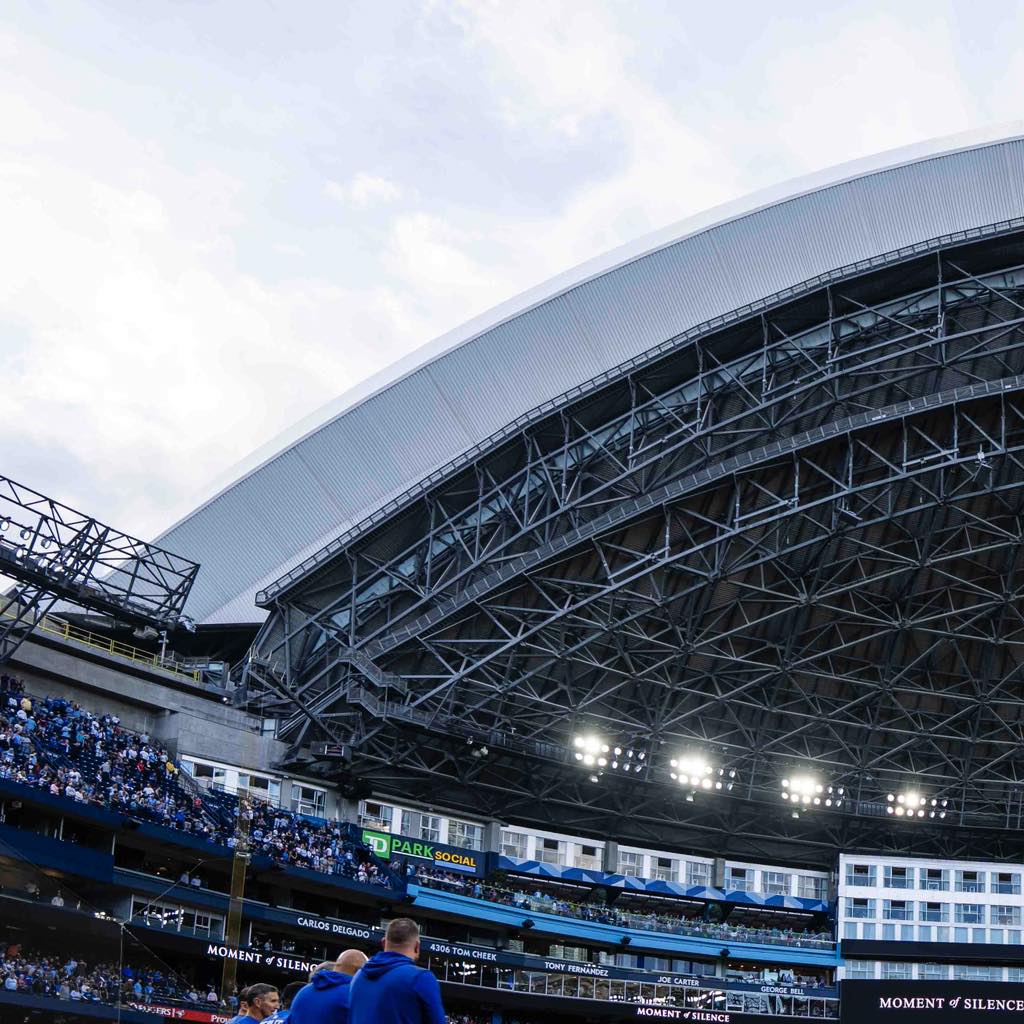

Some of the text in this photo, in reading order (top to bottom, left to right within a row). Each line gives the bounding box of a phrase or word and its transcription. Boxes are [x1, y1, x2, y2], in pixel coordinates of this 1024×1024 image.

[365, 835, 476, 867] TD PARK SOCIAL
[297, 917, 370, 939] CARLOS DELGADO
[207, 944, 318, 972] MOMENT of SILENC
[429, 943, 497, 962] 4306 TOM CHEEK
[544, 961, 566, 972] TONY
[657, 976, 700, 987] JOE CARTER
[760, 985, 804, 995] GEORGE BELL
[879, 996, 1024, 1011] MOMENT of SILENCE
[637, 1007, 730, 1023] MOMENT of SILENCE
